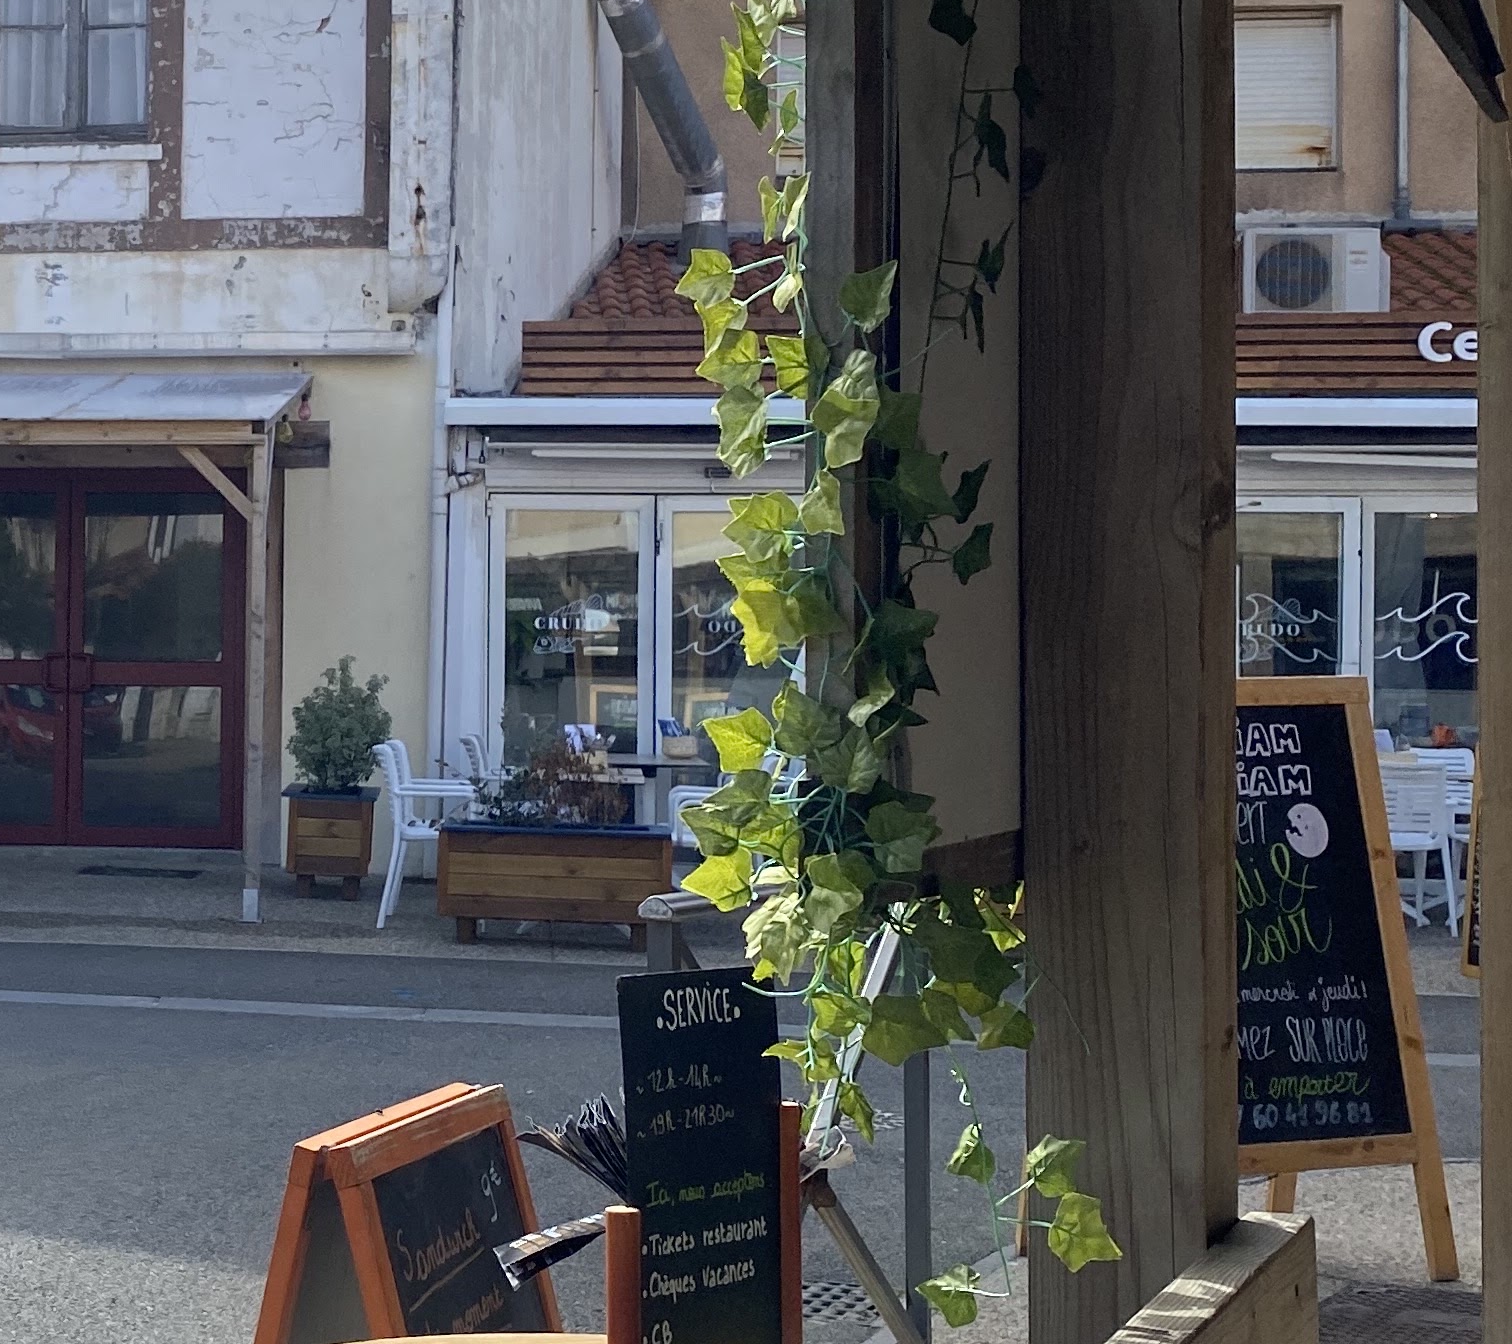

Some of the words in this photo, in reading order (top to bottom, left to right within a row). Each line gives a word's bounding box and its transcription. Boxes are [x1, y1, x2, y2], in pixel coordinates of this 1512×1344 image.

[1241, 907, 1333, 972] soir
[1285, 1015, 1323, 1064] SUR
[396, 1206, 481, 1282] Sandwich
[648, 1230, 696, 1257] Tickets
[702, 1215, 768, 1247] restaurant
[701, 1258, 756, 1289] Vacances
